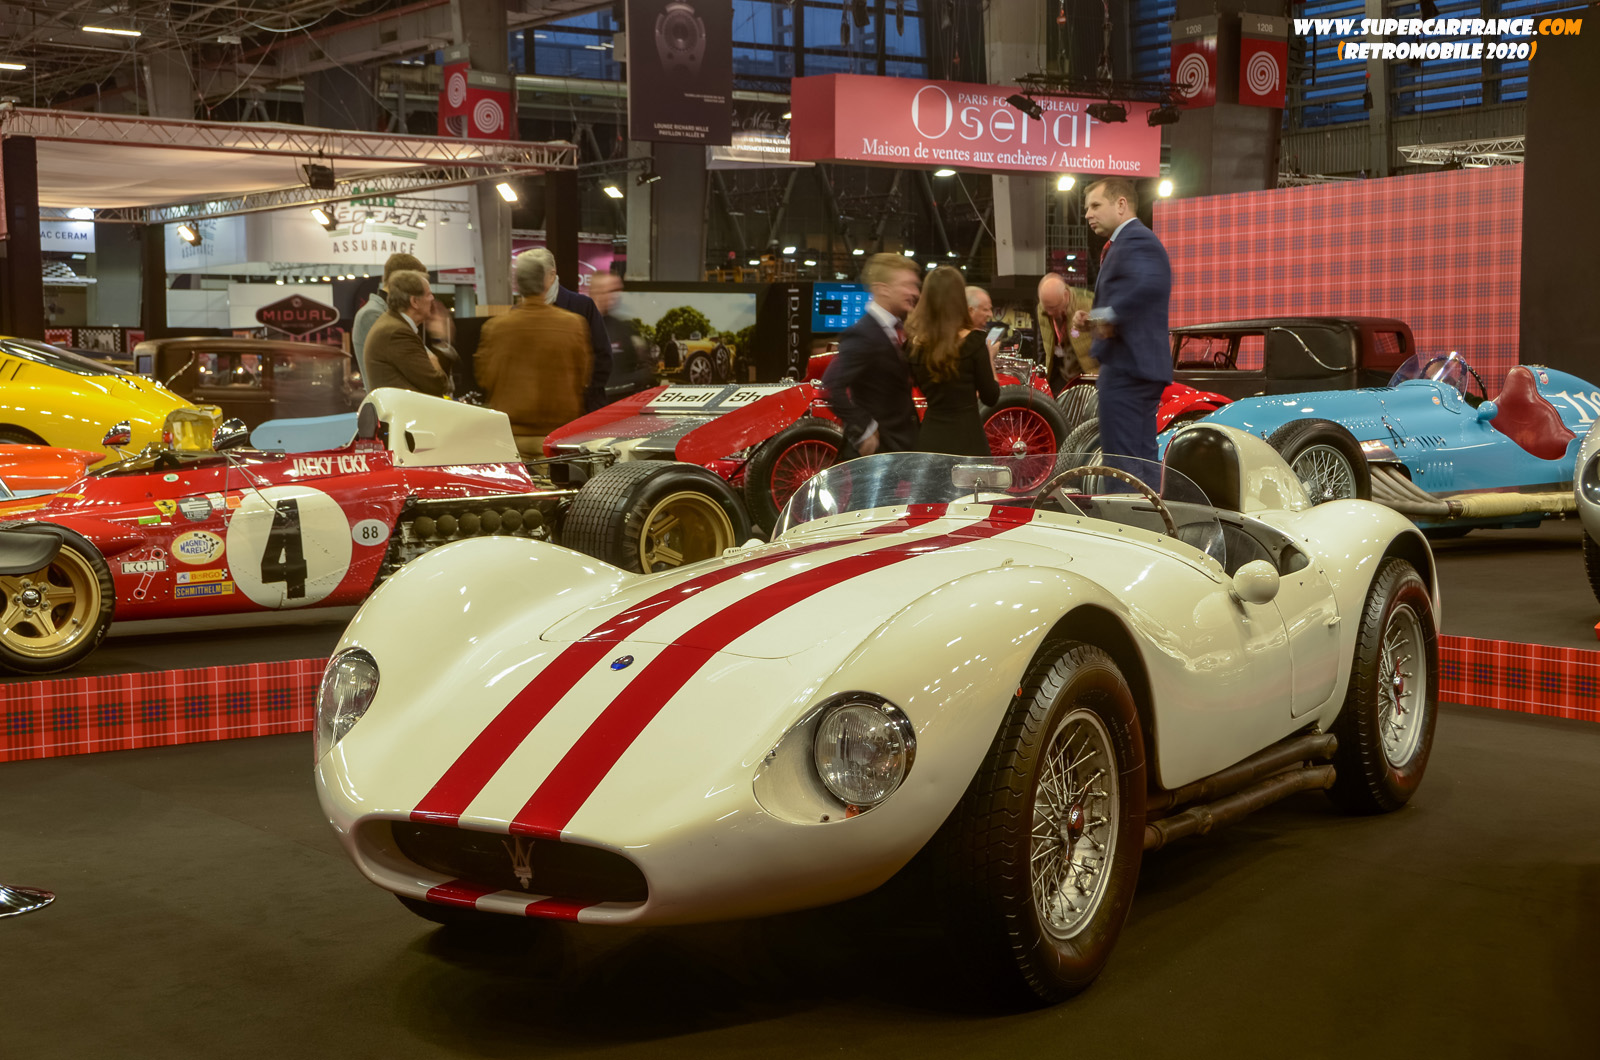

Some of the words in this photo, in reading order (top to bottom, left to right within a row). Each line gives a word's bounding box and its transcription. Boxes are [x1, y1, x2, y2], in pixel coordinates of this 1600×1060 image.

[1186, 24, 1202, 34] 1208
[1257, 23, 1273, 33] 1208
[958, 93, 988, 106] PARIS
[654, 122, 673, 130] LOUNGE
[674, 123, 695, 131] RICHARD
[862, 138, 910, 157] Maison
[914, 142, 929, 158] de
[932, 148, 970, 161] ventes
[973, 150, 993, 162] aux
[997, 149, 1047, 166] enchères
[1059, 152, 1105, 169] Auction
[1108, 155, 1140, 171] house
[55, 231, 88, 240] CERAM
[333, 239, 416, 256] ASSURANCE
[263, 310, 332, 321] MIDUAL
[656, 392, 715, 402] Shell
[728, 391, 764, 403] Sh
[289, 456, 332, 477] JACKY
[337, 454, 370, 474] ICKX
[362, 525, 379, 540] 88
[261, 498, 308, 599] 4
[122, 560, 165, 574] KONI
[191, 571, 220, 580] BORGO
[177, 584, 221, 597] SCHMITTHELM
